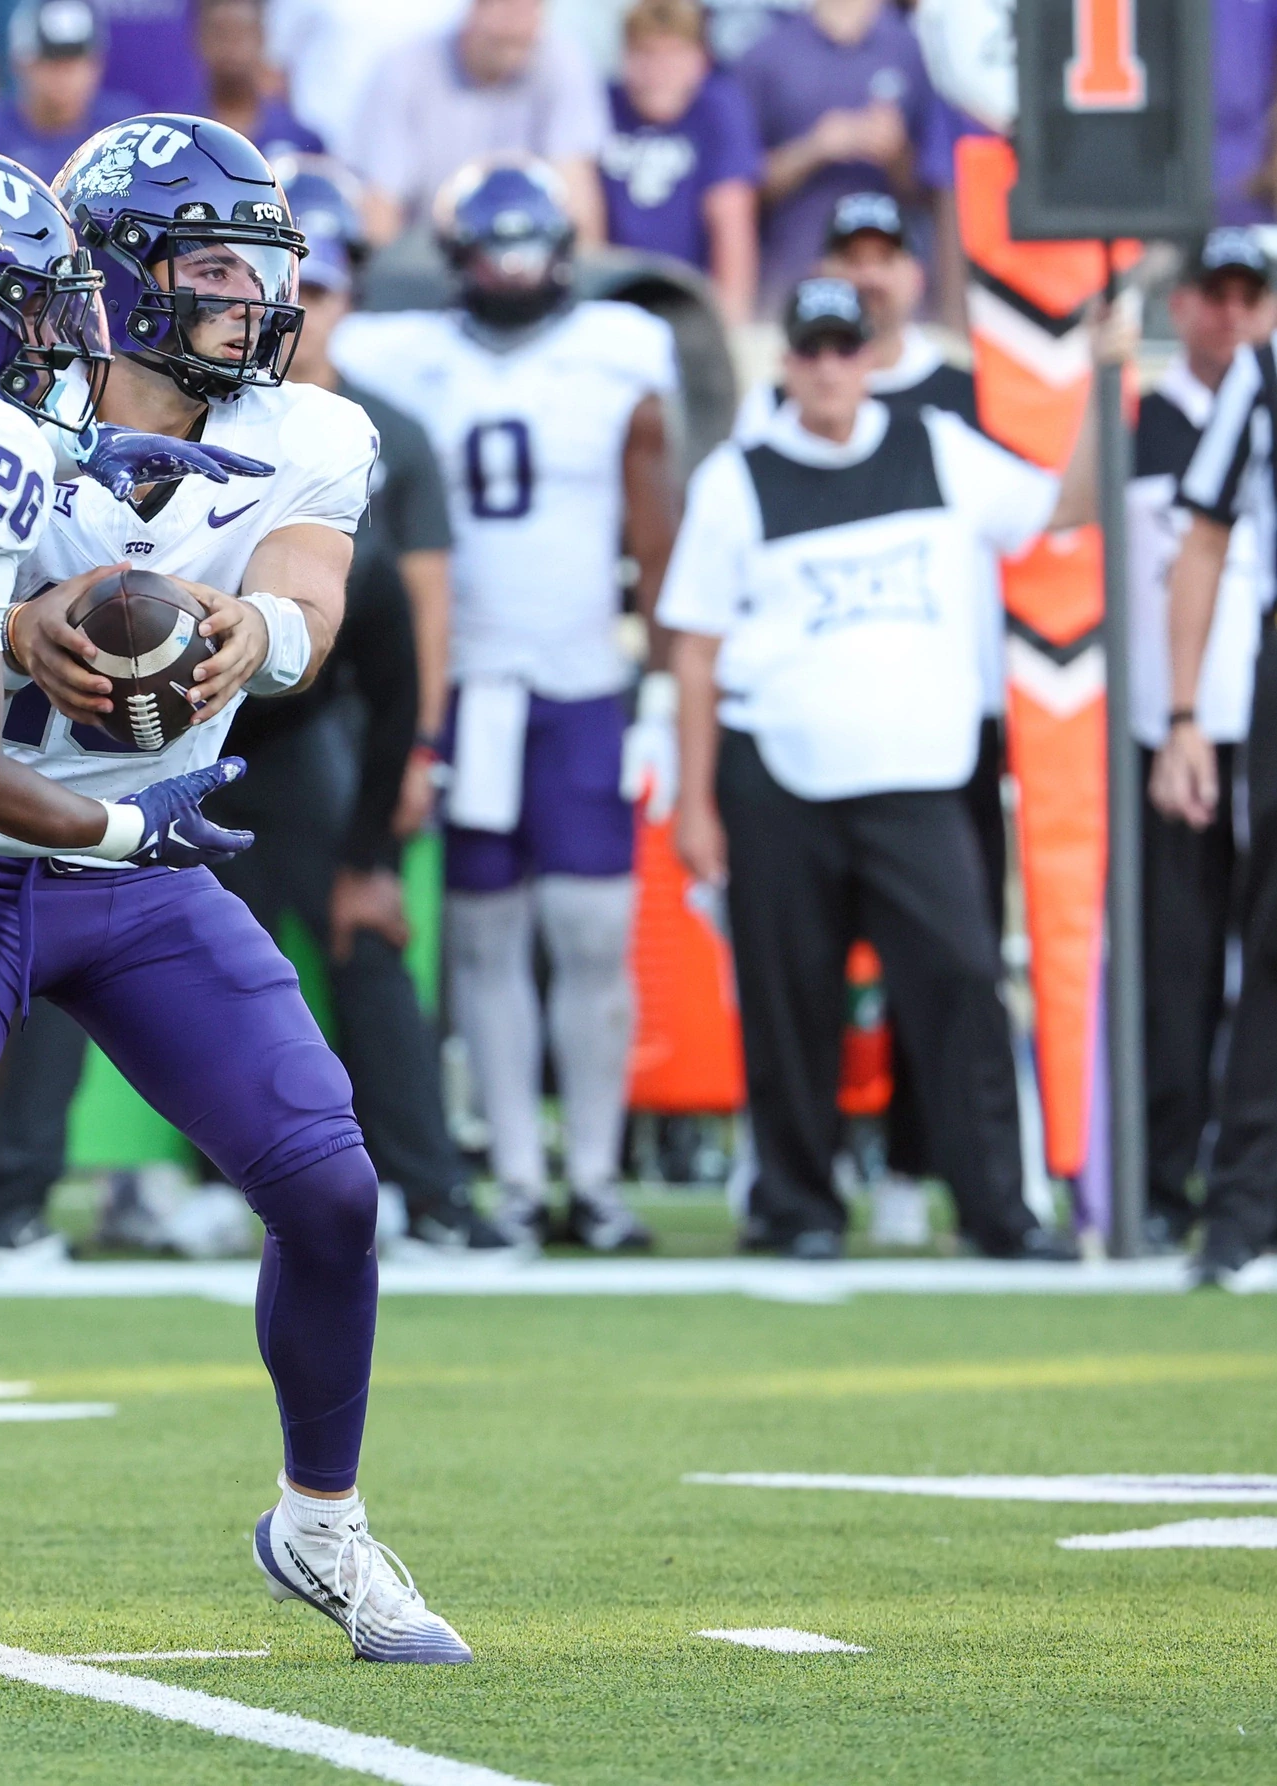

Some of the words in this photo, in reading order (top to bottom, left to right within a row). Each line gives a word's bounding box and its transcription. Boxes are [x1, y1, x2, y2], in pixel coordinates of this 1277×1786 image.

[252, 202, 283, 224] TCU
[465, 419, 532, 519] 0
[125, 541, 155, 555] TCU
